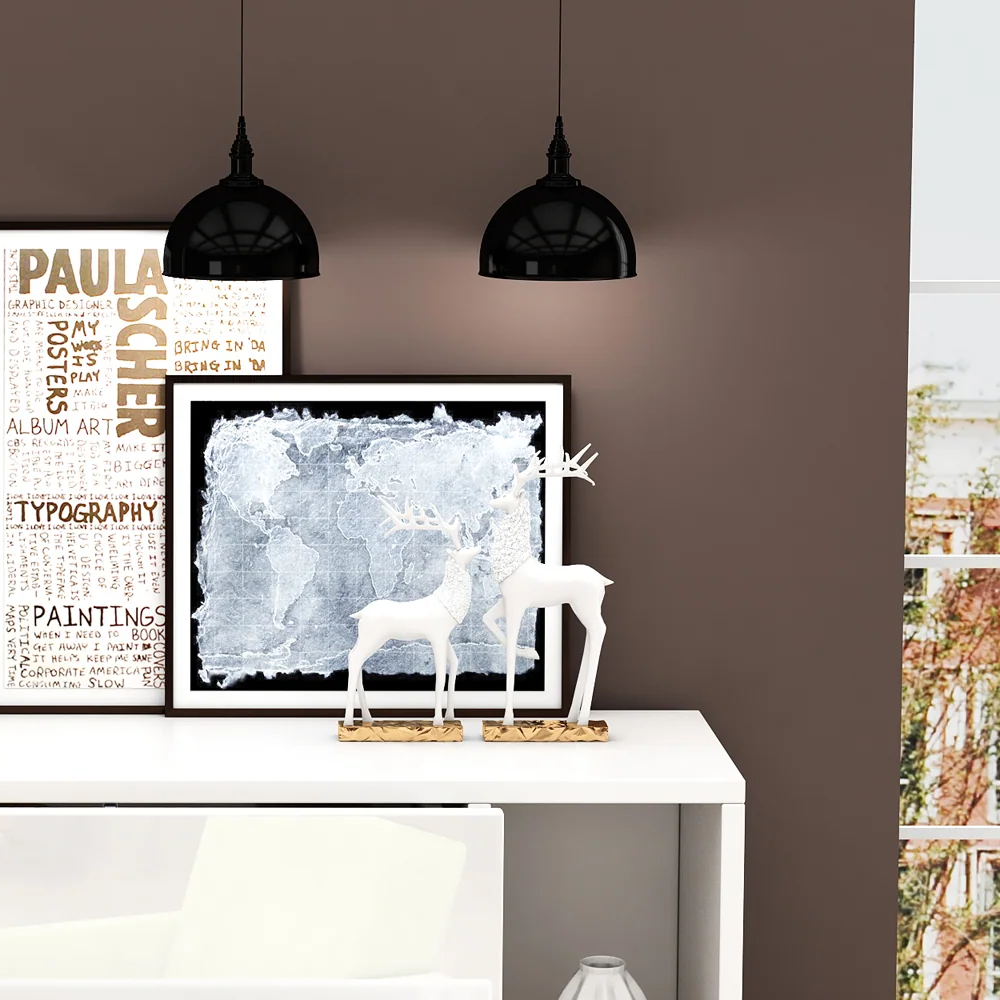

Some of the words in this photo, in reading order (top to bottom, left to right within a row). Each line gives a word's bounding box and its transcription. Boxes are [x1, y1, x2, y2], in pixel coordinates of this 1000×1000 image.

[19, 248, 168, 297] PAULA
[8, 299, 55, 310] GRAPHIC
[59, 299, 114, 310] DESIGNER
[71, 320, 100, 338] MY
[174, 340, 220, 356] BRING
[226, 341, 243, 352] IN
[46, 320, 68, 415] POSTERS
[72, 353, 99, 367] IS
[116, 296, 167, 438] SCHER
[174, 360, 220, 374] BRING
[224, 359, 241, 371] IN
[71, 369, 100, 384] PLAY
[6, 417, 69, 435] ALBUM
[77, 418, 113, 435] ART
[116, 443, 147, 453] MAKE
[152, 443, 165, 452] IT
[14, 501, 158, 523] TYPOGRAPHY
[147, 533, 156, 550] USE
[149, 555, 156, 567] IT
[151, 571, 160, 594] EVEN
[6, 604, 16, 633] MAPS
[33, 605, 165, 626] PAINTINGS
[19, 604, 30, 668] POLITICAL
[33, 631, 60, 639] WHEN
[76, 630, 101, 638] NEED
[108, 630, 119, 638] TO
[132, 628, 165, 641] BOOK
[33, 643, 54, 652] GET
[59, 643, 88, 651] AWAY
[94, 643, 100, 651] I
[107, 643, 139, 651] PAINT
[33, 654, 45, 662] IT
[115, 654, 128, 662] ME
[153, 642, 165, 688] COVERS
[20, 666, 86, 678] CORPORATE
[89, 666, 140, 675] AMERICA
[88, 677, 124, 688] SLOW
